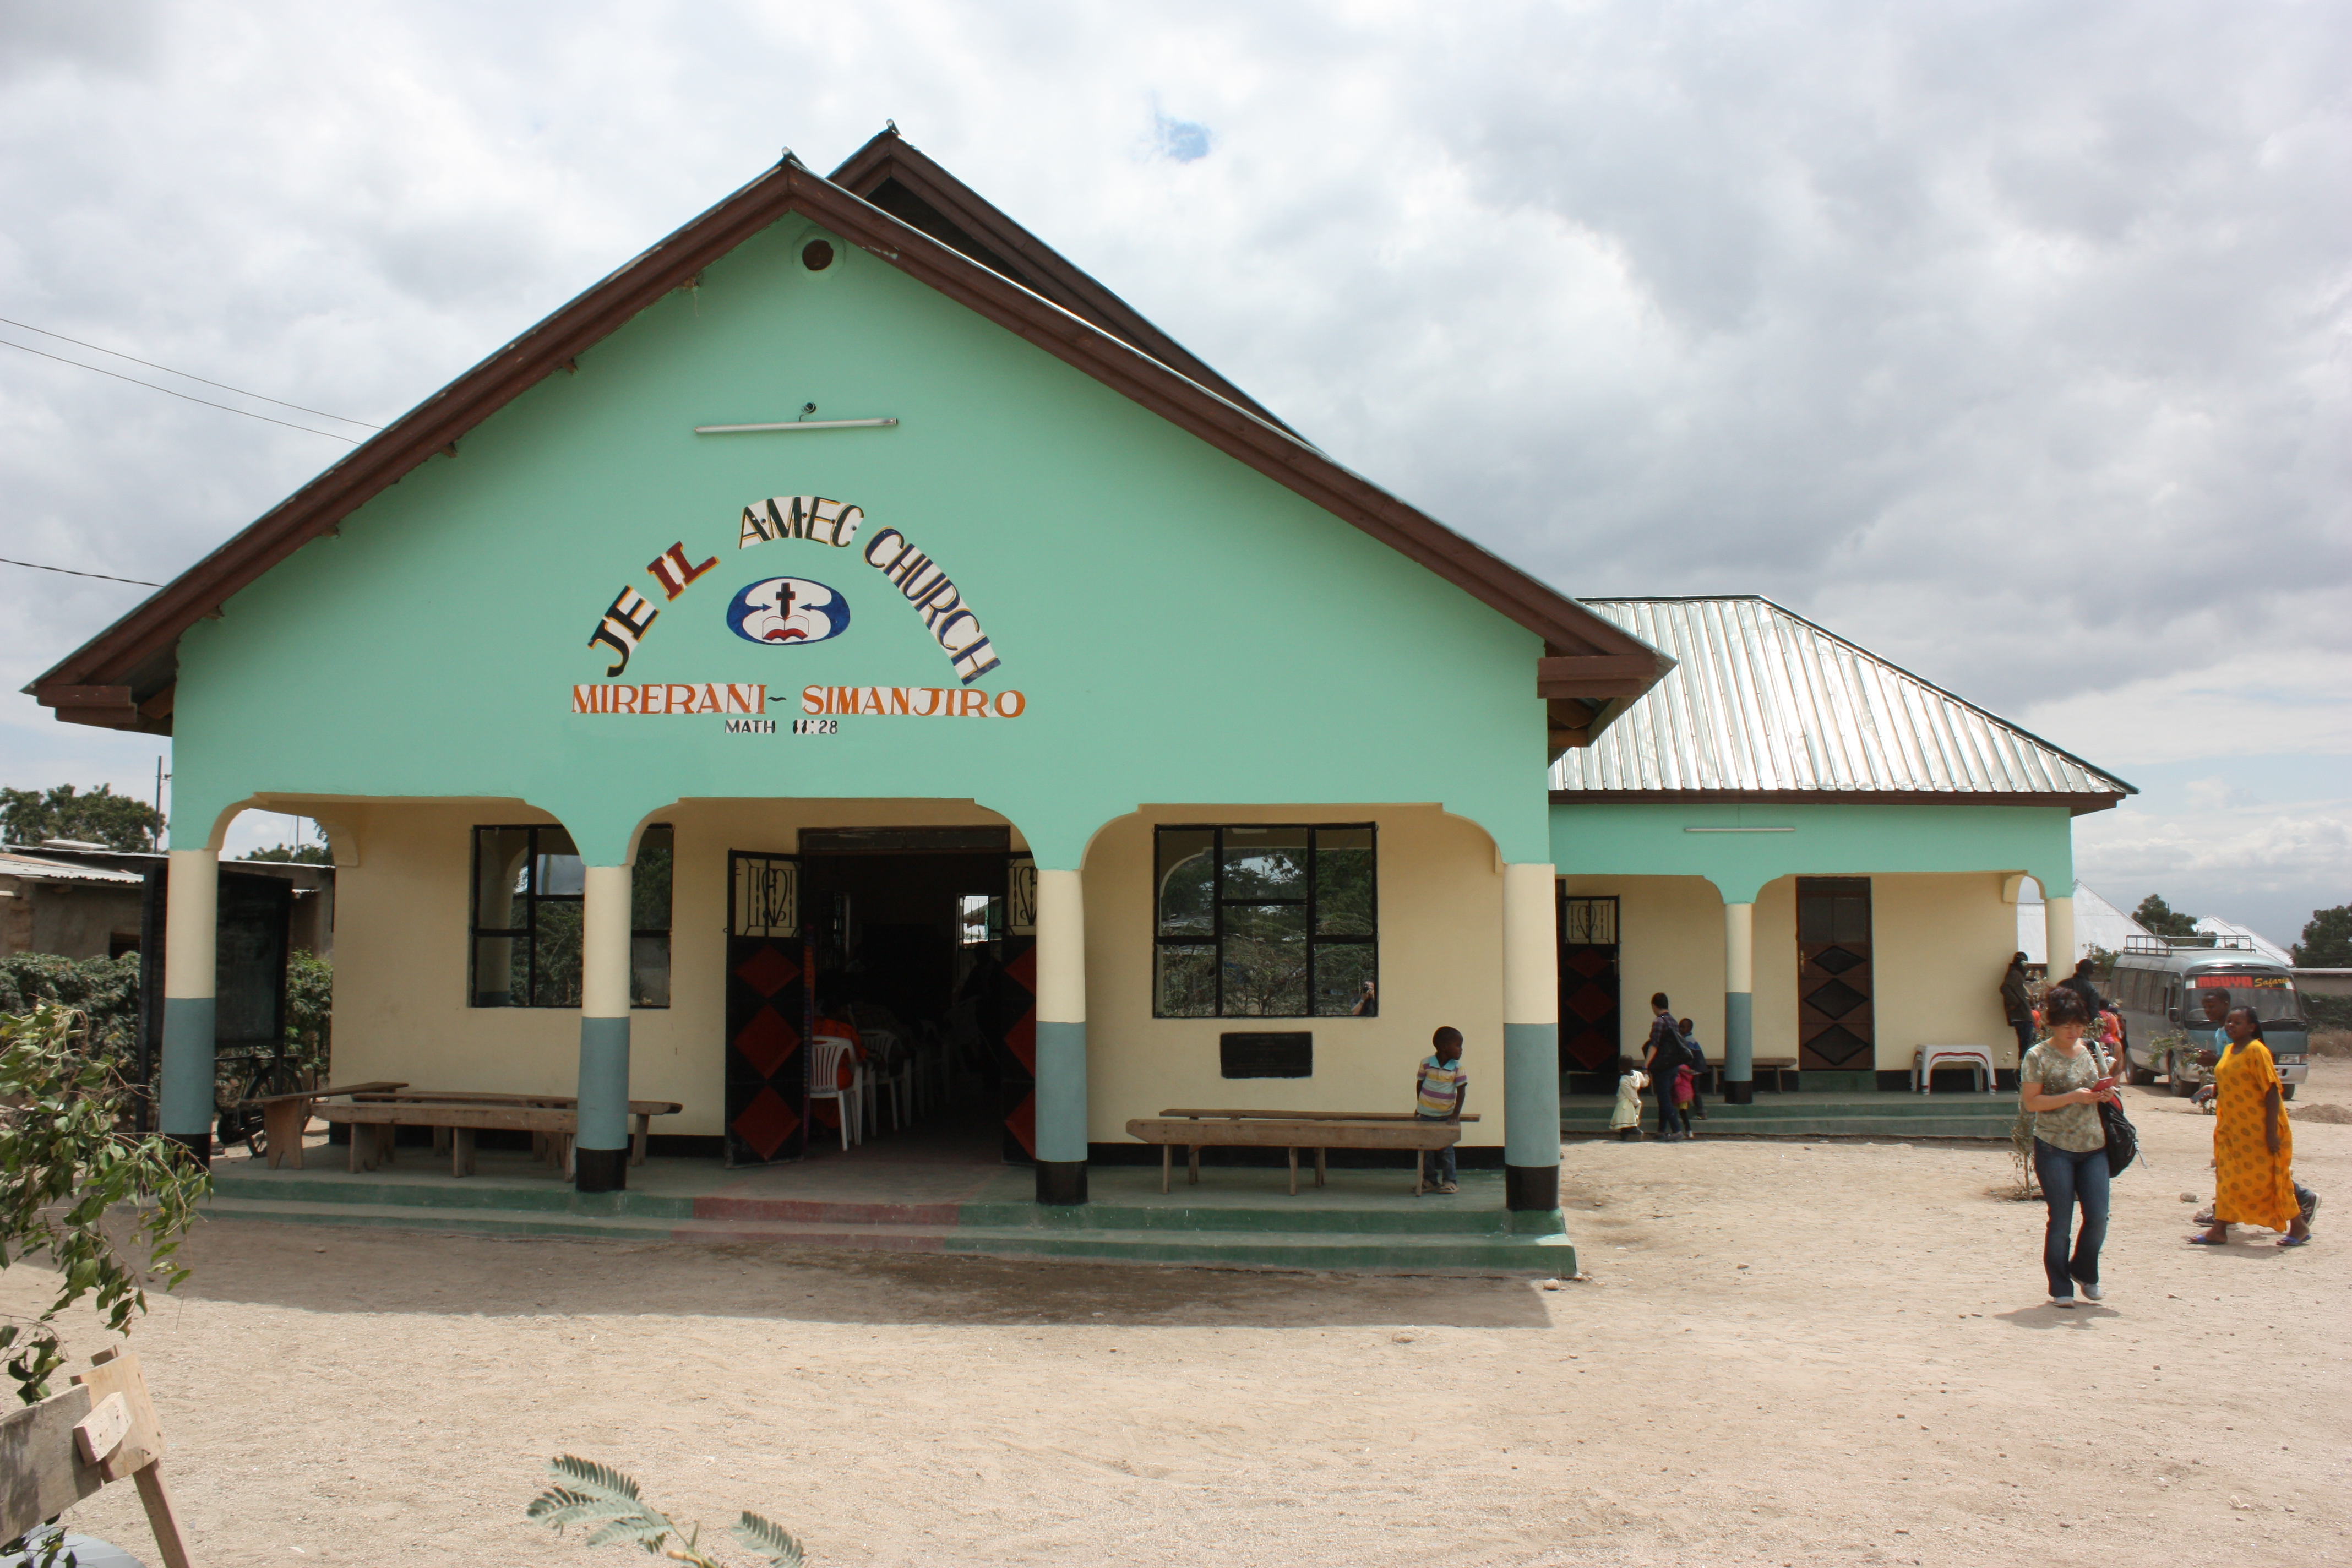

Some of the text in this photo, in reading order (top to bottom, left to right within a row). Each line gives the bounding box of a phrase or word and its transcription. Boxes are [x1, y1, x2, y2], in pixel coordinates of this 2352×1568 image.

[587, 585, 660, 677] JE
[645, 541, 720, 602] IL
[863, 526, 1001, 686] CHURCH
[802, 685, 1026, 718] SIMANJIRO
[725, 720, 838, 734] MATH 11:28
[2198, 976, 2253, 987] MSUYA
